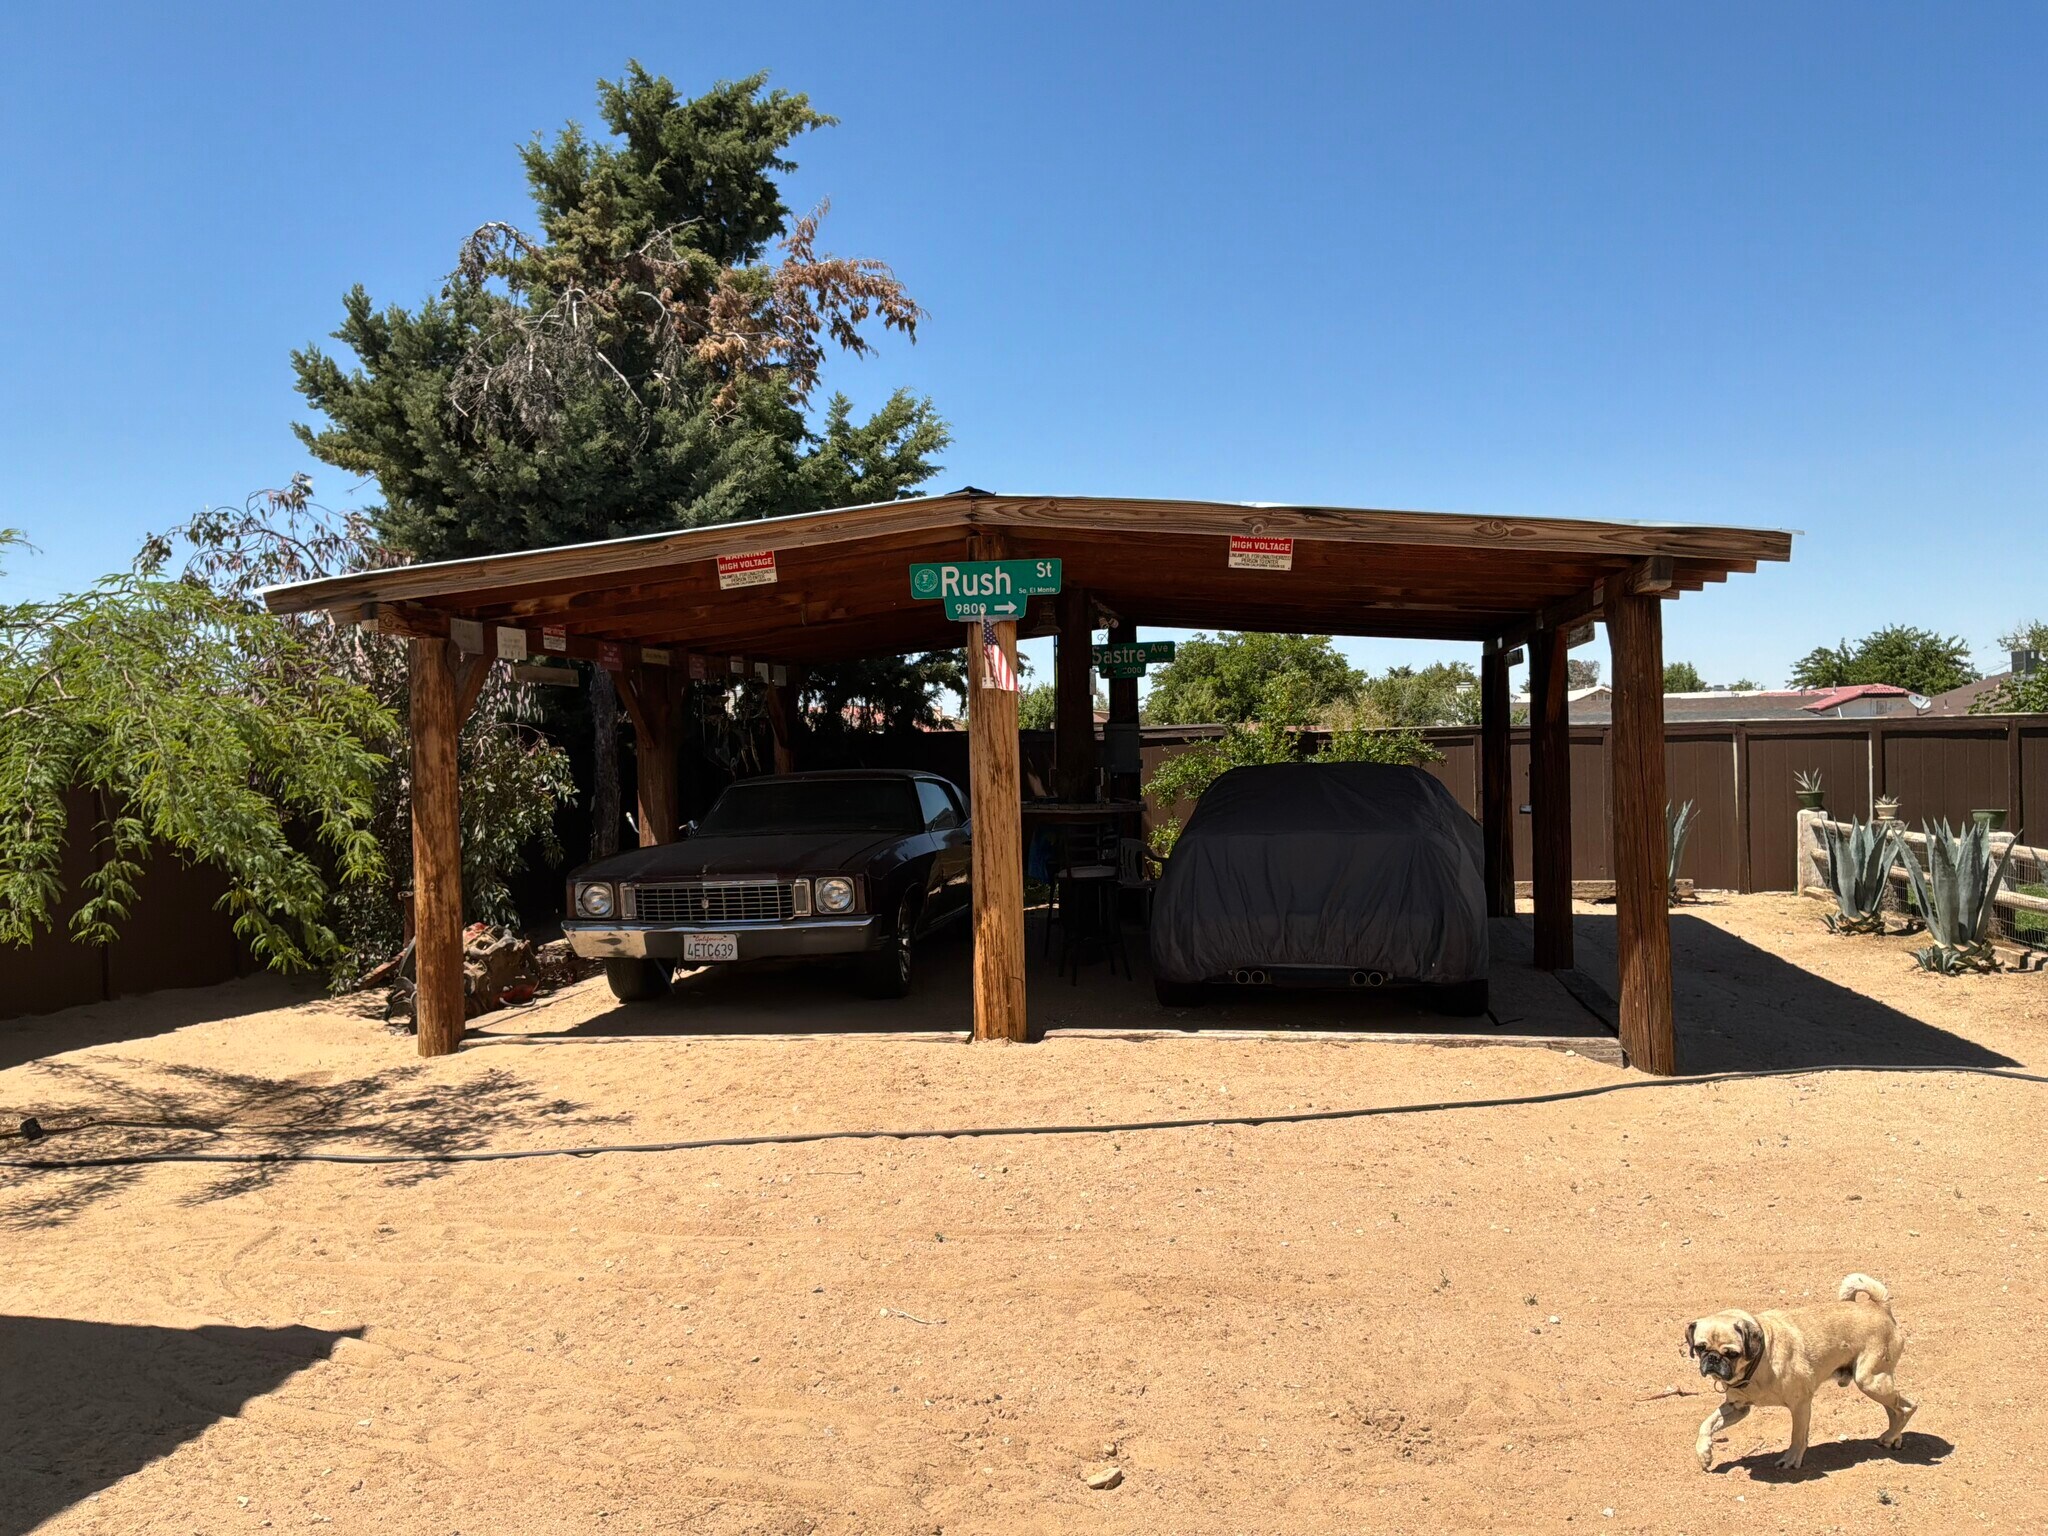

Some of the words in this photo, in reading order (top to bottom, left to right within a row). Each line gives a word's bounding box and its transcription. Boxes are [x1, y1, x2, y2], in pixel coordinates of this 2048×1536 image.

[1232, 541, 1252, 549] HIGH
[1254, 542, 1291, 551] VOLTAGE
[720, 562, 738, 571] HIGH
[740, 557, 773, 568] VOLTAGE
[941, 566, 1011, 596] Rush
[1036, 562, 1052, 577] St
[955, 603, 986, 614] 9800
[1092, 646, 1146, 665] Sastre
[1151, 644, 1169, 653] Ave
[695, 935, 727, 943] California
[688, 943, 733, 957] 4ETC639
